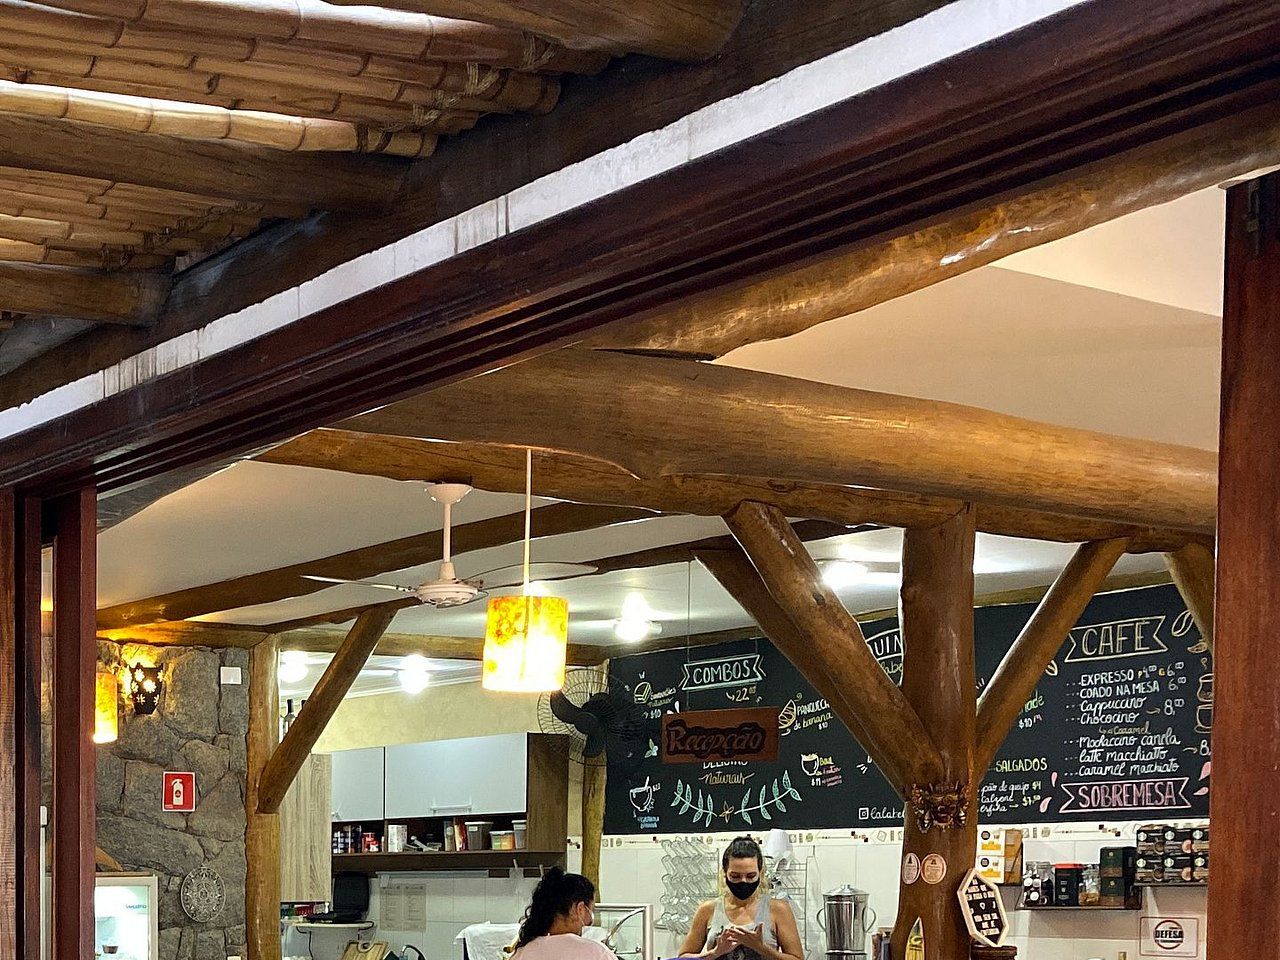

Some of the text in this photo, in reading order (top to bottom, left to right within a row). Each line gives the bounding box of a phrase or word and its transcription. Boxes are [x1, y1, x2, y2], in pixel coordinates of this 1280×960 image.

[1082, 620, 1150, 655] CAFÉ
[693, 660, 751, 684] COMBOS
[1080, 669, 1134, 686] EXPRESSO
[1080, 687, 1112, 698] COADO
[1116, 684, 1130, 696] NA
[1132, 680, 1160, 694] MESA
[1080, 697, 1147, 716] Cappuccino
[793, 712, 833, 730] de banana
[667, 725, 762, 757] Recepção
[1141, 727, 1181, 745] canela
[995, 758, 1048, 772] SALGADOS
[999, 780, 1008, 791] de
[1079, 782, 1176, 808] SOBREMESA
[1154, 930, 1184, 938] DEFESA
